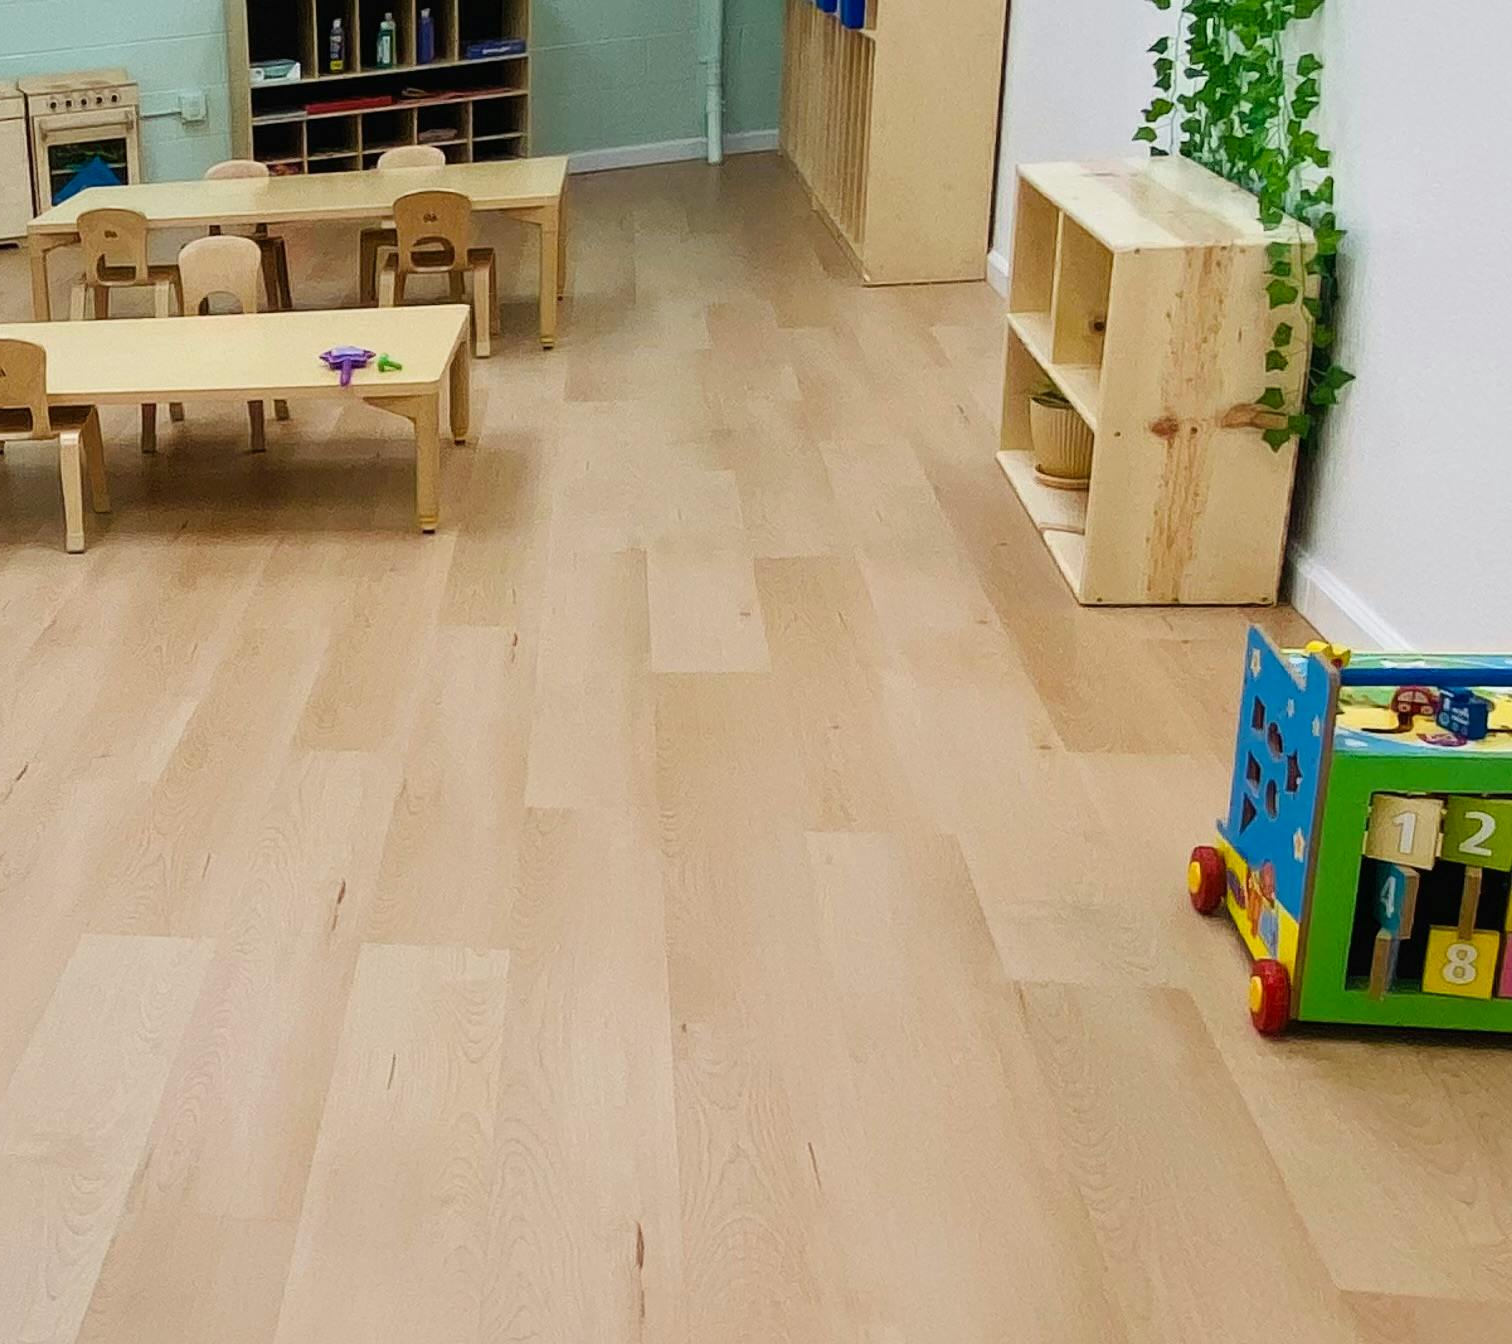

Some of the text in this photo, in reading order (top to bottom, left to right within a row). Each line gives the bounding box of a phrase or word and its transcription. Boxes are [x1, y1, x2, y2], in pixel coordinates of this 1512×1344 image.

[1392, 810, 1417, 854] 1
[1458, 811, 1496, 857] 2
[1380, 875, 1397, 919] 4
[1442, 943, 1478, 985] 8
